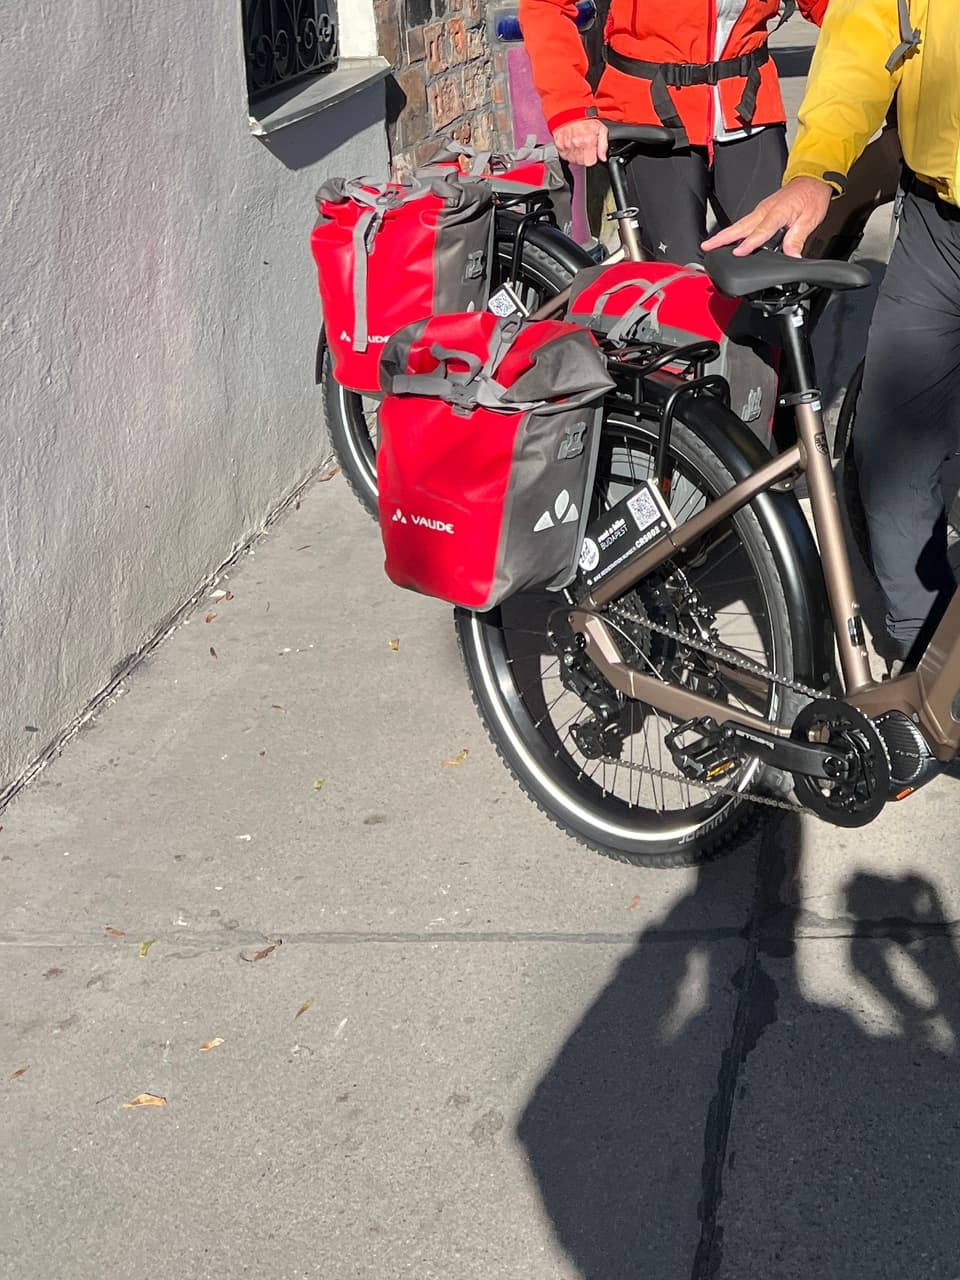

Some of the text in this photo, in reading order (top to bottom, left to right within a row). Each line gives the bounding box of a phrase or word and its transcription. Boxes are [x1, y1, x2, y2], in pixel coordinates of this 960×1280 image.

[367, 335, 390, 343] UDE
[411, 515, 455, 534] VAUDE
[600, 524, 628, 550] BUDAPEST
